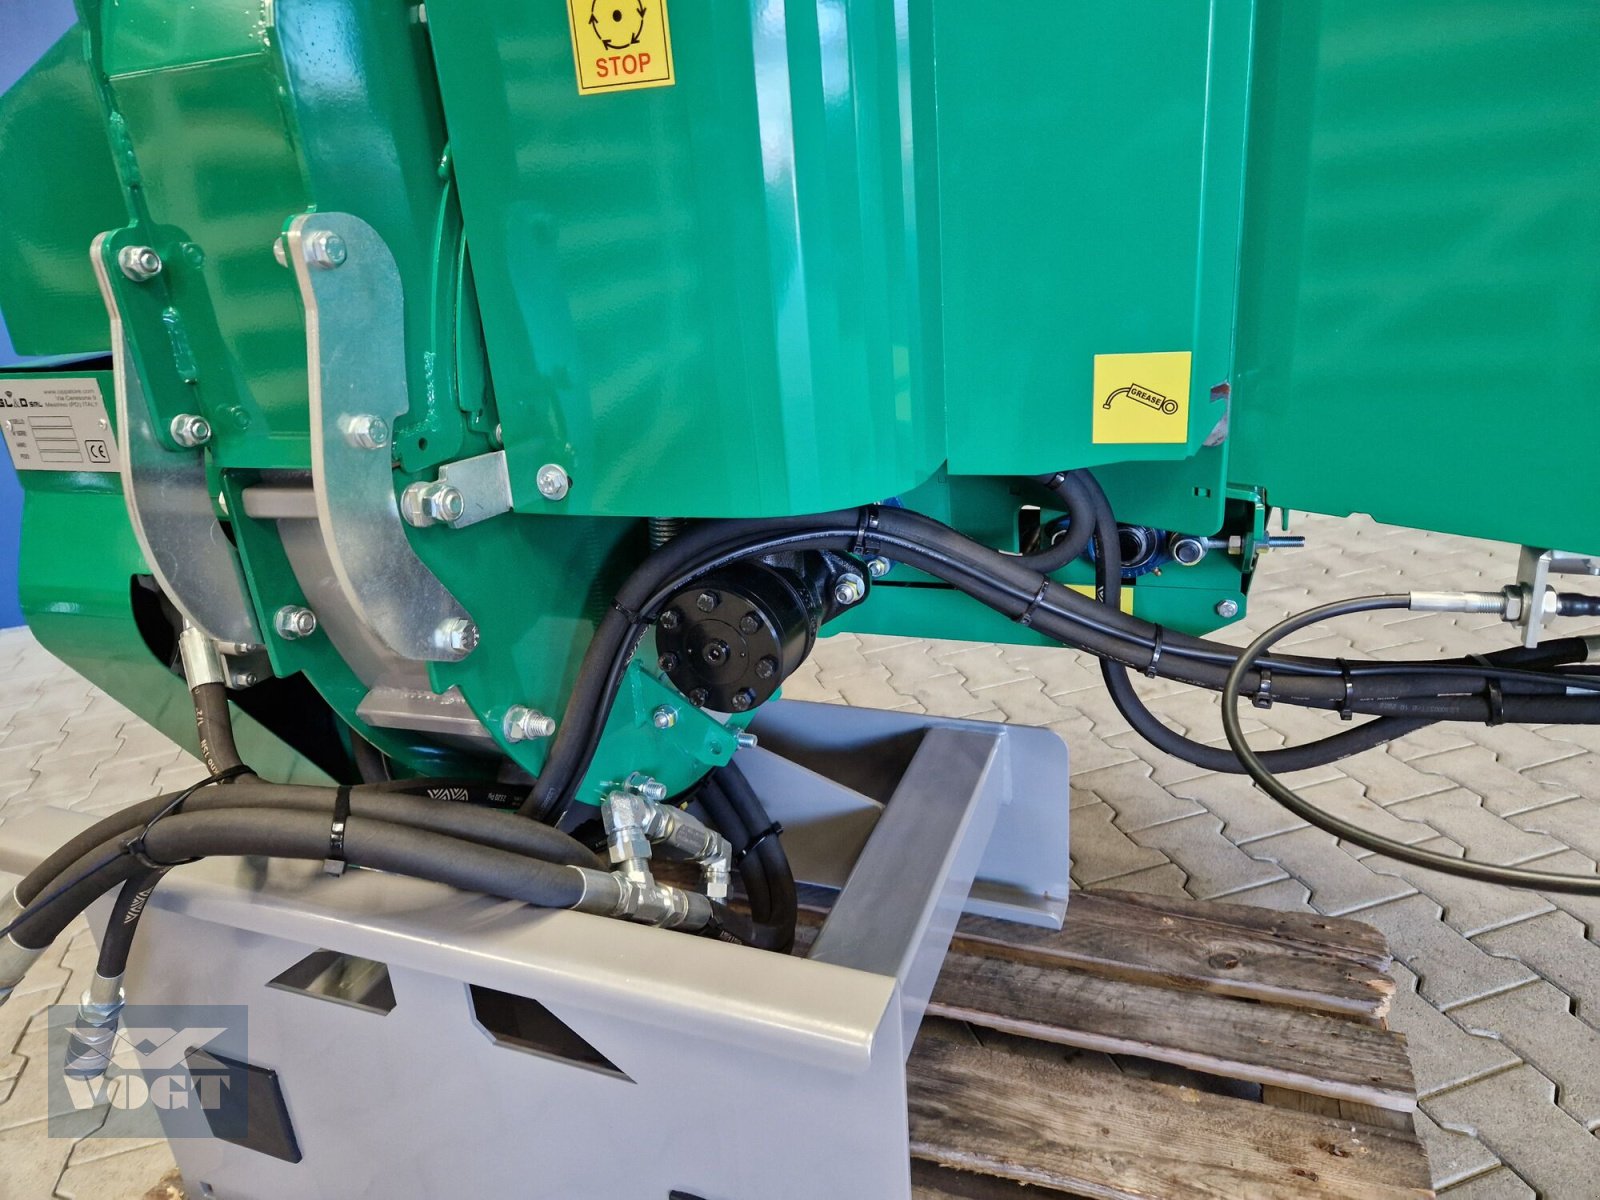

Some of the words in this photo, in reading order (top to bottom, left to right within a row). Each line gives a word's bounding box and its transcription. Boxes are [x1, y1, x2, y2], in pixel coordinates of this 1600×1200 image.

[596, 53, 651, 78] STOP
[1131, 388, 1161, 406] GREASE
[90, 445, 106, 458] CE
